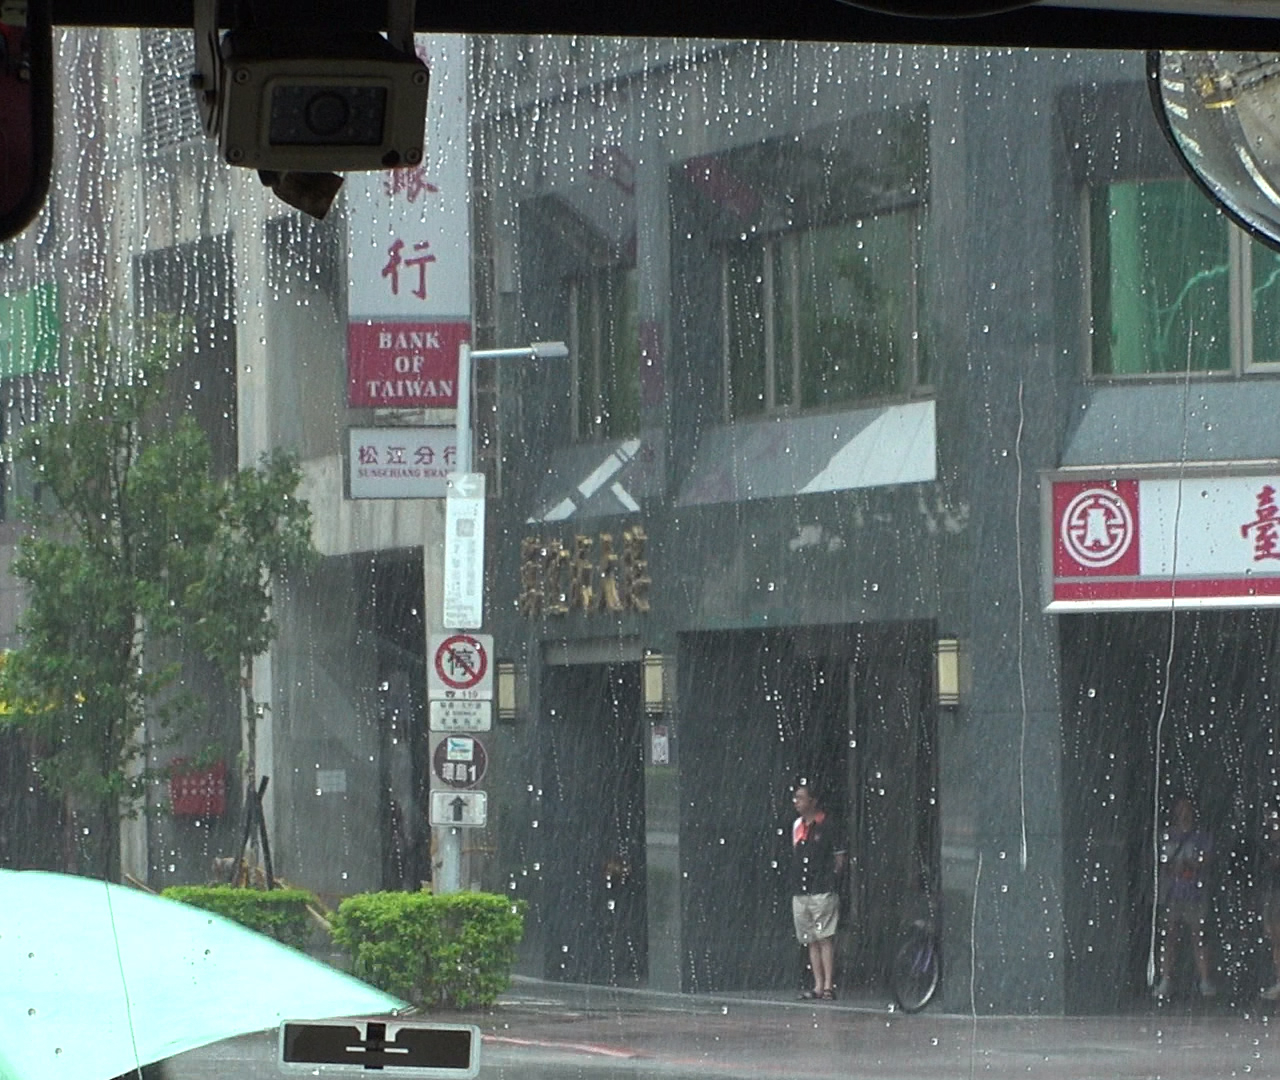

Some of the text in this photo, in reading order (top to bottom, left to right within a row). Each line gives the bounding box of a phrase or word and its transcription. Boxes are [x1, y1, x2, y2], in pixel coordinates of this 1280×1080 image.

[379, 332, 440, 349] BANK
[394, 356, 424, 373] OF
[367, 380, 453, 397] TAIWAN
[358, 445, 456, 465] 松江分行
[423, 469, 448, 478] BRAN
